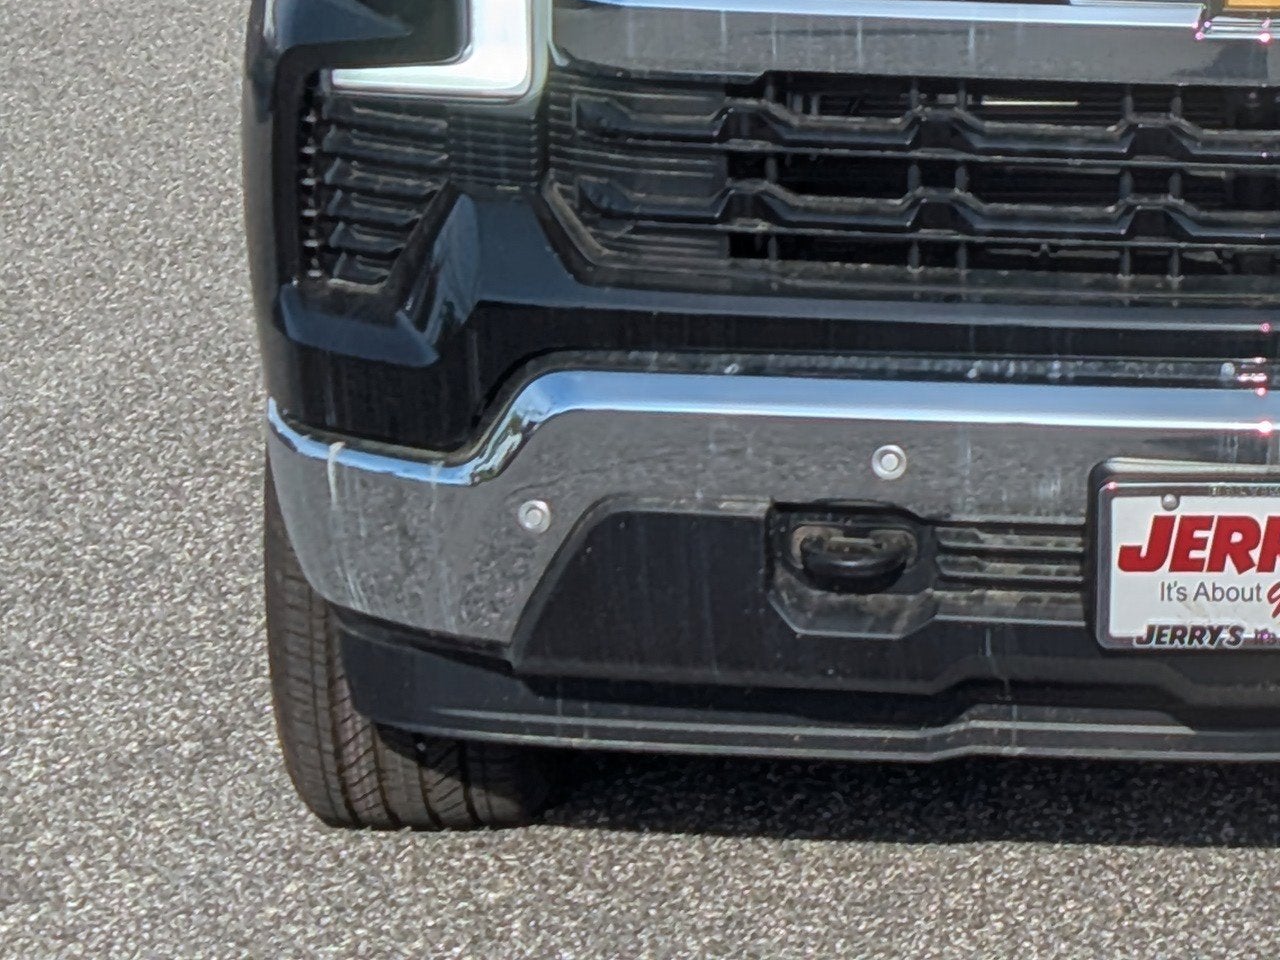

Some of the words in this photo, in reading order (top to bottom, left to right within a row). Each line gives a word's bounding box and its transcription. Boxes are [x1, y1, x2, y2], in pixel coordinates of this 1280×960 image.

[1160, 581, 1188, 602] It's
[1193, 581, 1263, 603] About
[1135, 624, 1244, 647] JERRY'S
